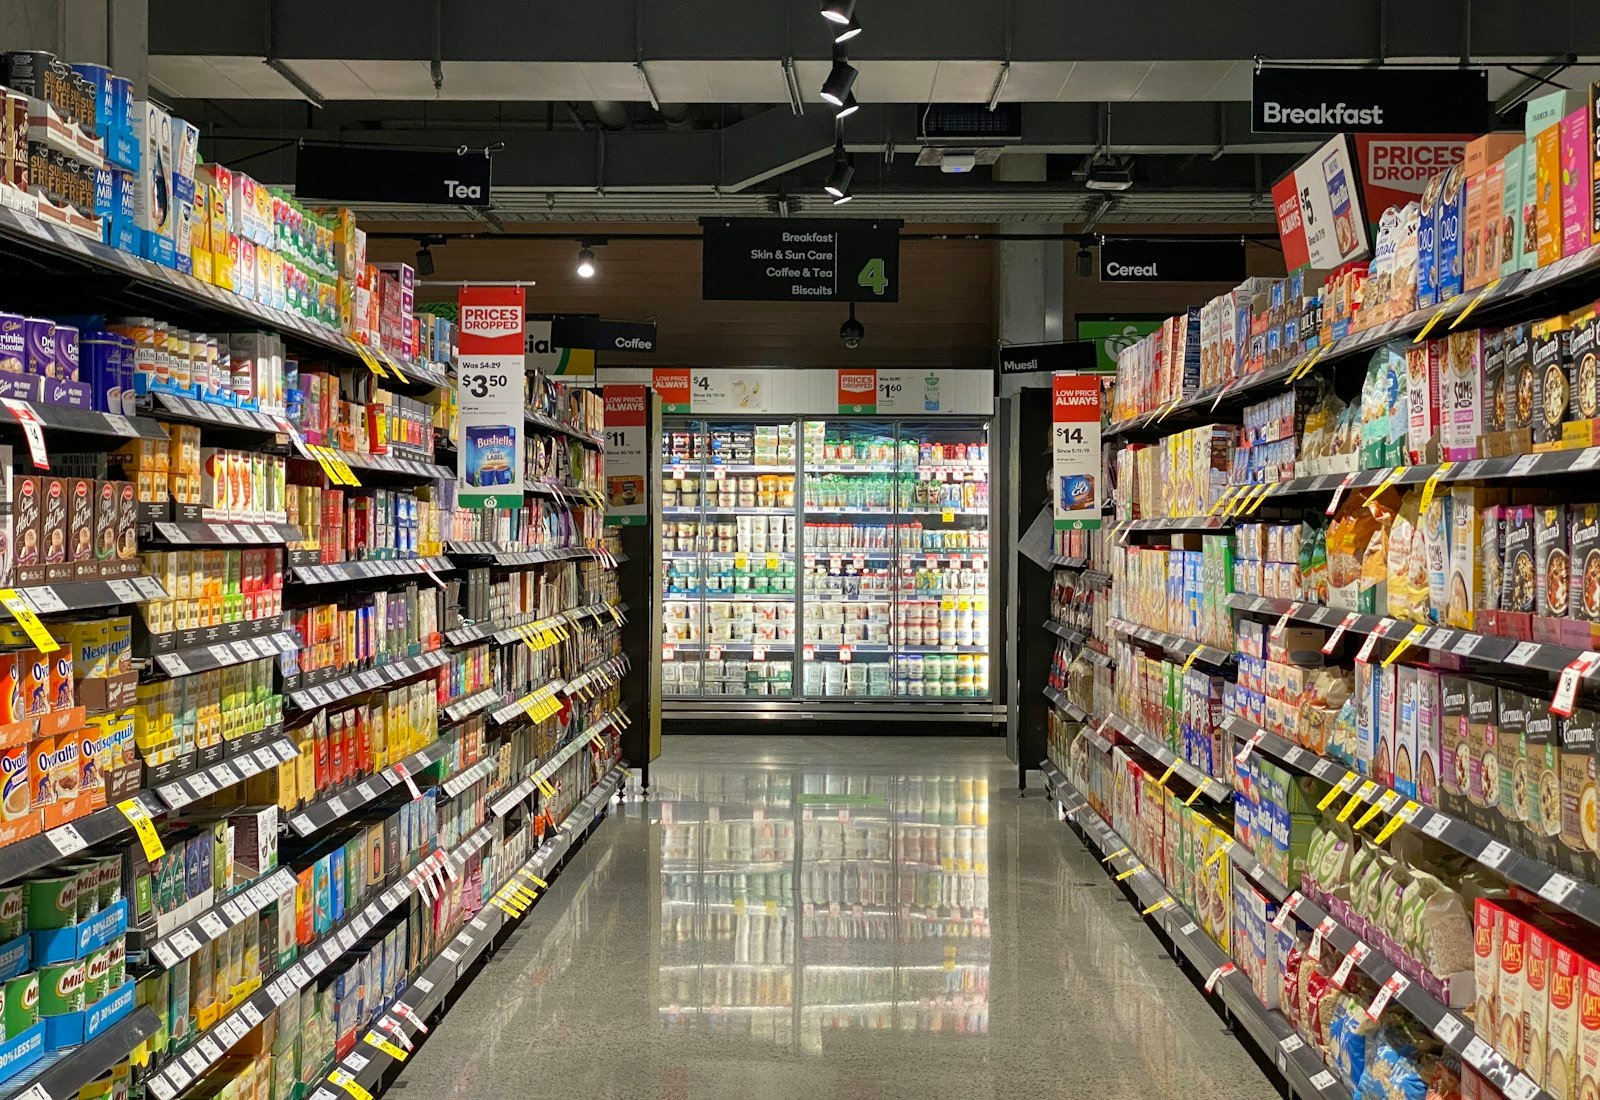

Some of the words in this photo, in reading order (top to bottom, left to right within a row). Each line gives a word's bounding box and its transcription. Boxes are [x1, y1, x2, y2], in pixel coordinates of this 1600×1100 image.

[1263, 102, 1384, 125] Breakfast
[1373, 146, 1465, 165] PRICES
[1373, 166, 1444, 181] DROPP
[444, 180, 481, 198] Tea
[1281, 210, 1301, 236] ALWAYS
[782, 232, 833, 243] Breakfast
[750, 250, 773, 260] Skin
[775, 250, 784, 260] &
[785, 250, 805, 260] Sun
[807, 251, 833, 261] Care
[766, 267, 800, 277] Coffee
[802, 268, 811, 278] &
[812, 268, 833, 278] Tea
[857, 258, 888, 295] 4
[1106, 261, 1158, 277] Cereal
[792, 285, 832, 295] Biscuits
[464, 309, 519, 320] PRICES
[464, 321, 518, 330] DROPPED
[615, 337, 652, 349] Coffee
[1004, 359, 1038, 371] Muesli
[693, 376, 710, 390] $4
[842, 376, 873, 384] PRICES
[605, 403, 644, 411] ALWAYS
[1055, 396, 1098, 406] ALWAYS
[477, 435, 513, 448] Bushells
[606, 431, 625, 446] $11
[1056, 428, 1083, 444] $14
[1507, 918, 1520, 934] UNCLE
[1476, 925, 1491, 946] OATS
[1502, 940, 1521, 961] OATS
[1557, 947, 1571, 964] UNCLE
[1528, 955, 1545, 980] OATS
[1552, 973, 1571, 998] OATS
[100, 1007, 113, 1022] 30%
[111, 999, 124, 1015] LESS
[14, 1042, 30, 1058] LESS
